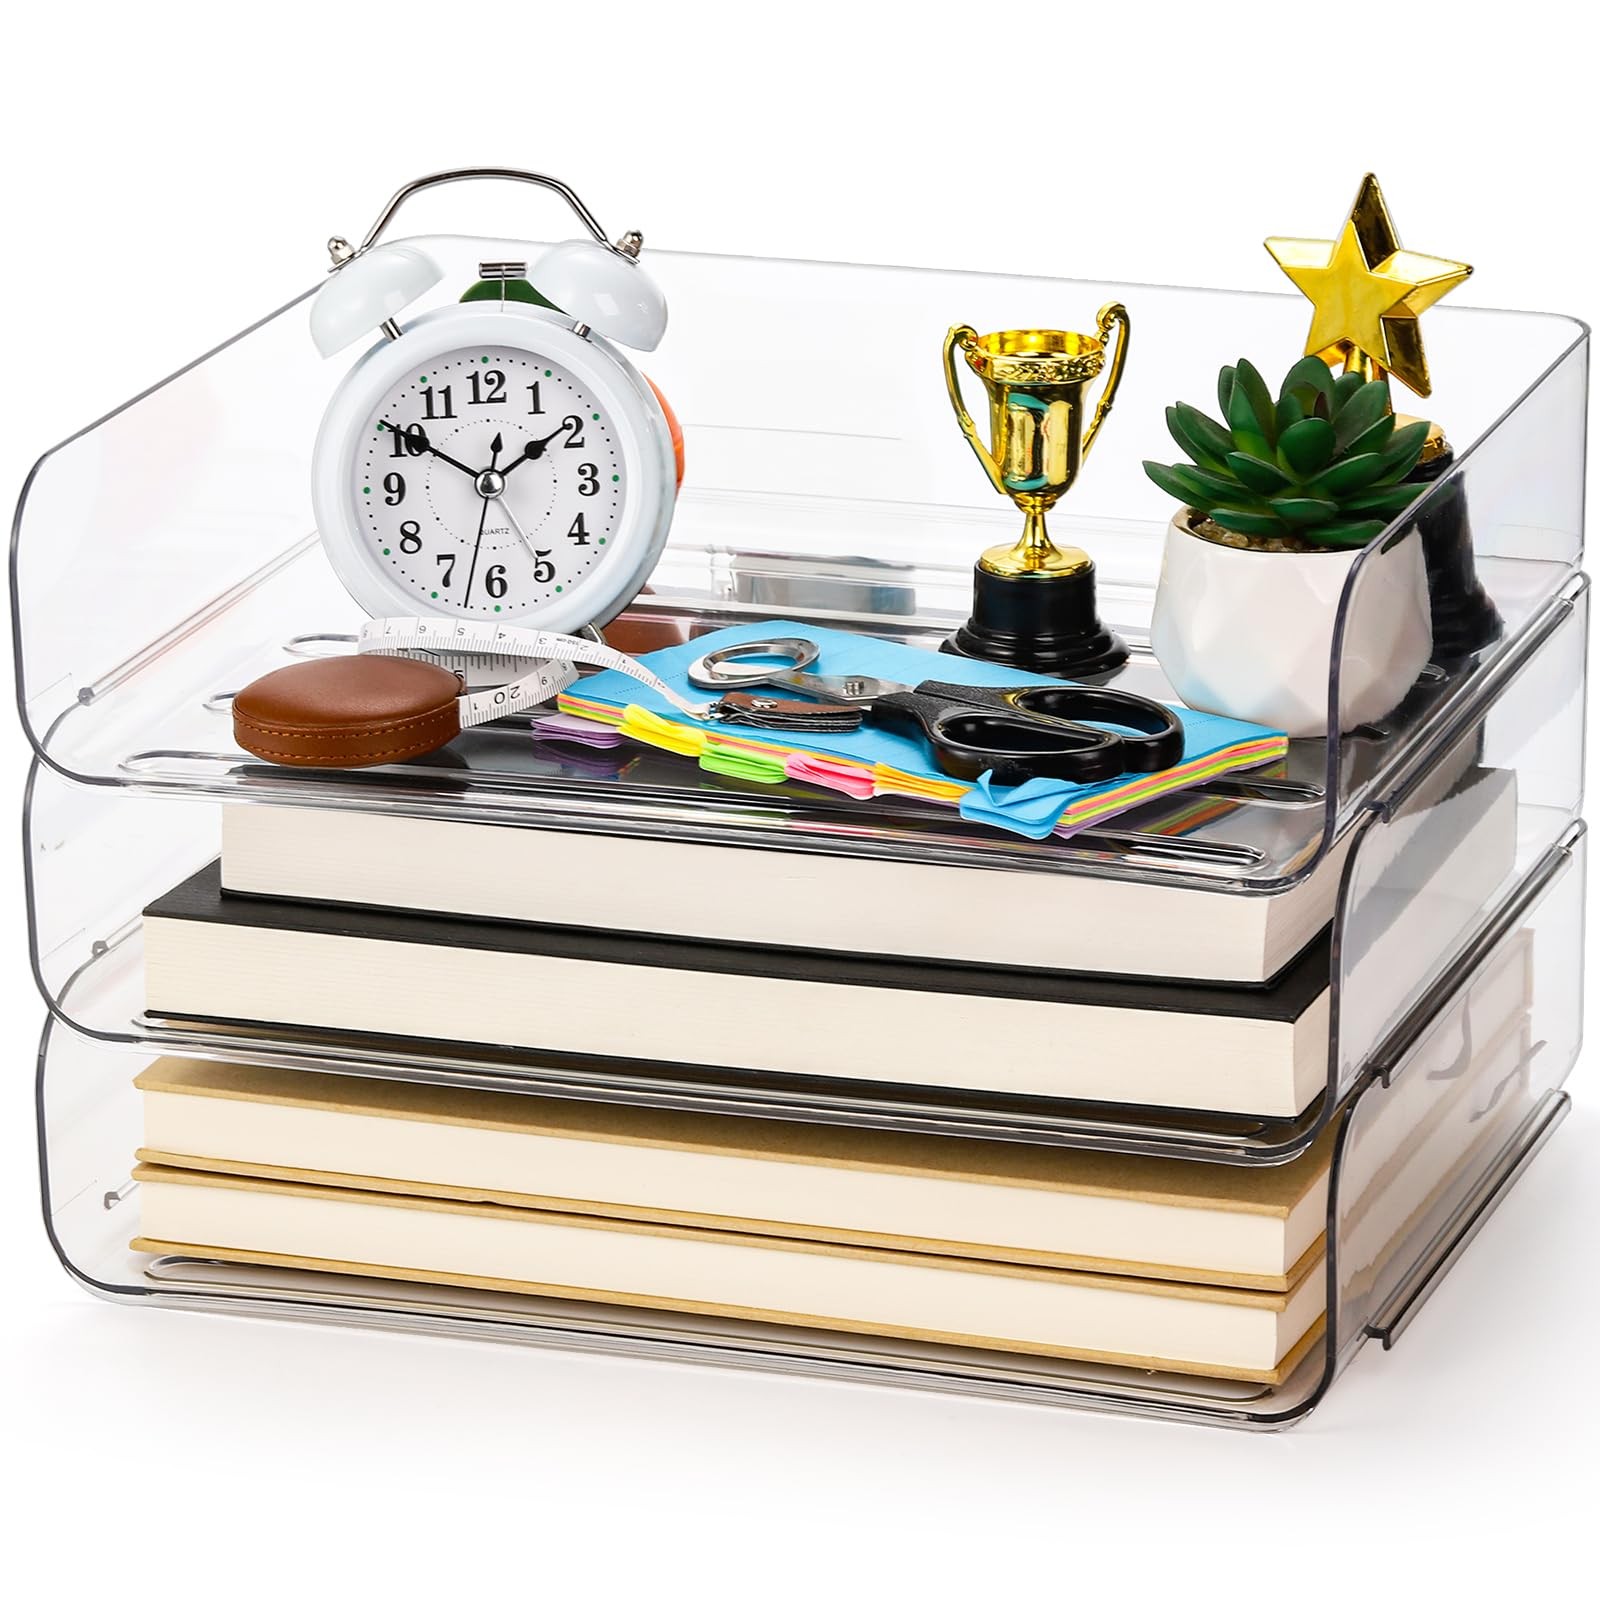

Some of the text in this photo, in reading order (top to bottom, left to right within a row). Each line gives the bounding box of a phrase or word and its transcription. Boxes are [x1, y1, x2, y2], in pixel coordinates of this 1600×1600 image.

[419, 385, 458, 420] 11
[466, 370, 507, 404] 12
[526, 381, 546, 414] 1
[387, 421, 426, 457] 10
[561, 415, 584, 448] 2
[383, 472, 406, 506] 9
[577, 463, 600, 496] 3
[400, 520, 422, 554] 8
[567, 512, 590, 546] 4
[437, 554, 455, 588] 7
[486, 565, 508, 599] 6
[534, 549, 556, 583] 5
[498, 632, 506, 640] 4
[538, 637, 548, 645] 3
